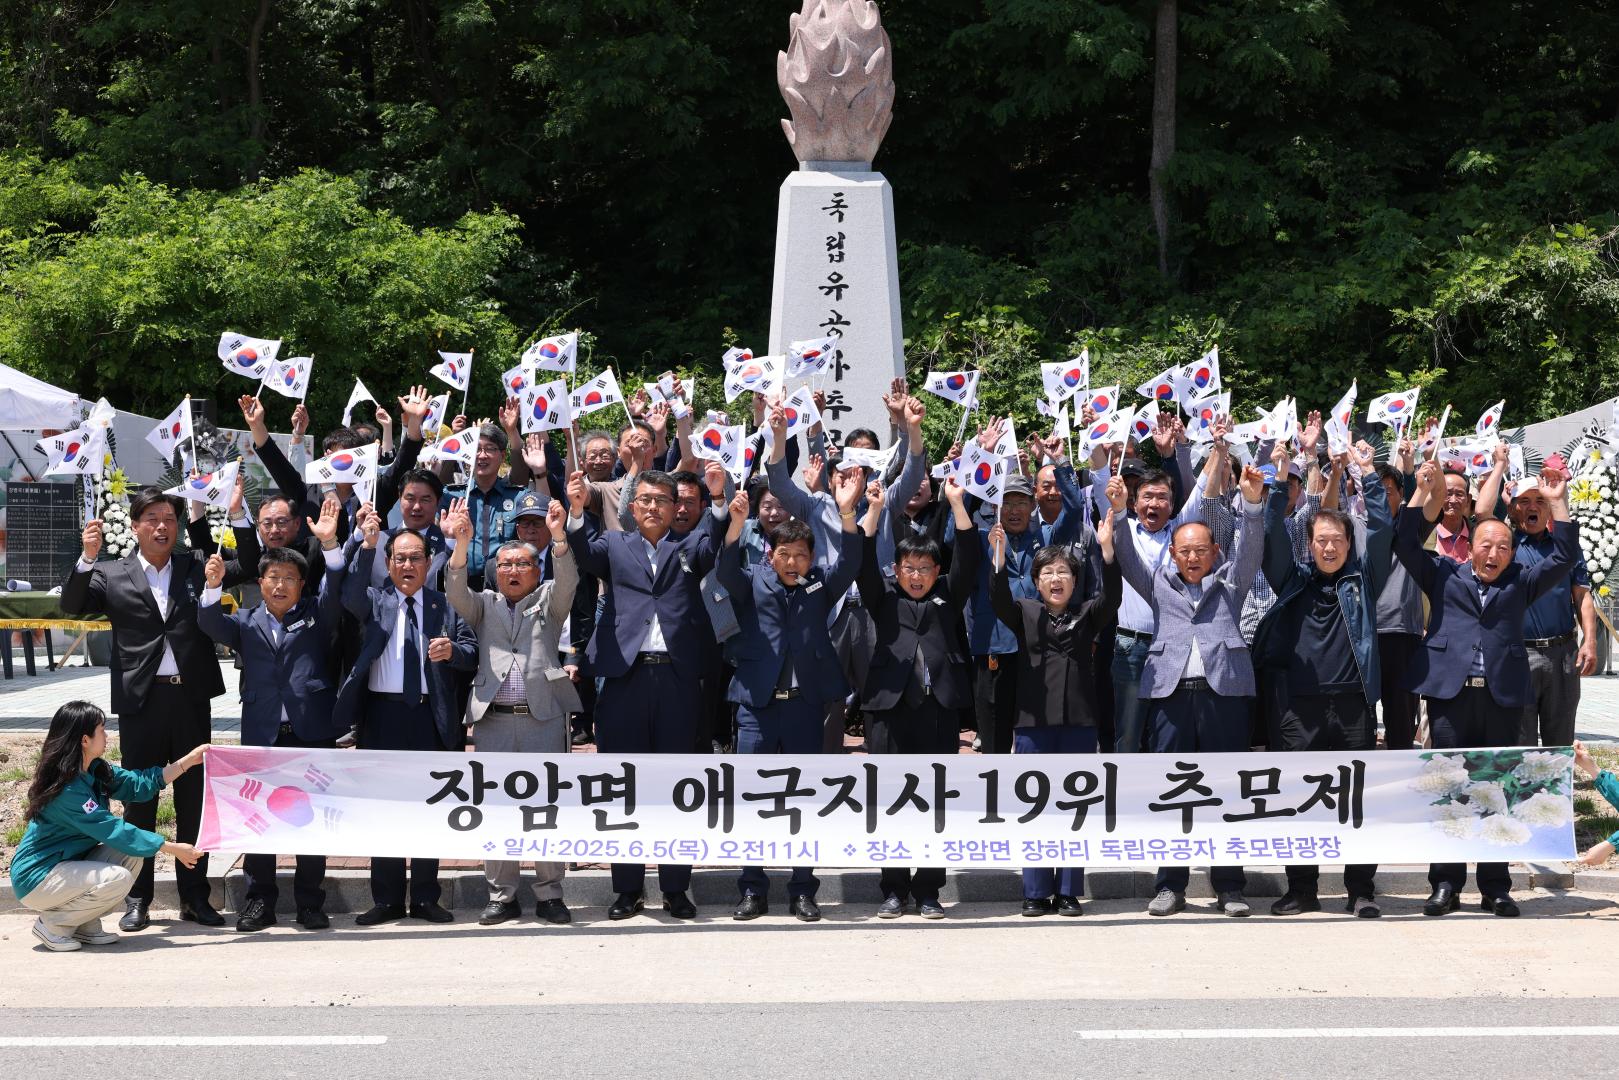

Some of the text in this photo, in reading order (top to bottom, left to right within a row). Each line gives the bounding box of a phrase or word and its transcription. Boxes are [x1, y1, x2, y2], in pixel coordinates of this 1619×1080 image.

[426, 759, 1367, 835] 장암면 애국지사19위 추모제
[717, 840, 820, 862] 오전11시
[866, 840, 913, 862] 장소
[942, 839, 1011, 862] 장암면
[1021, 839, 1091, 862] 장하리
[1100, 837, 1217, 861] 독립유공자
[1225, 835, 1342, 860] 추모탑광장
